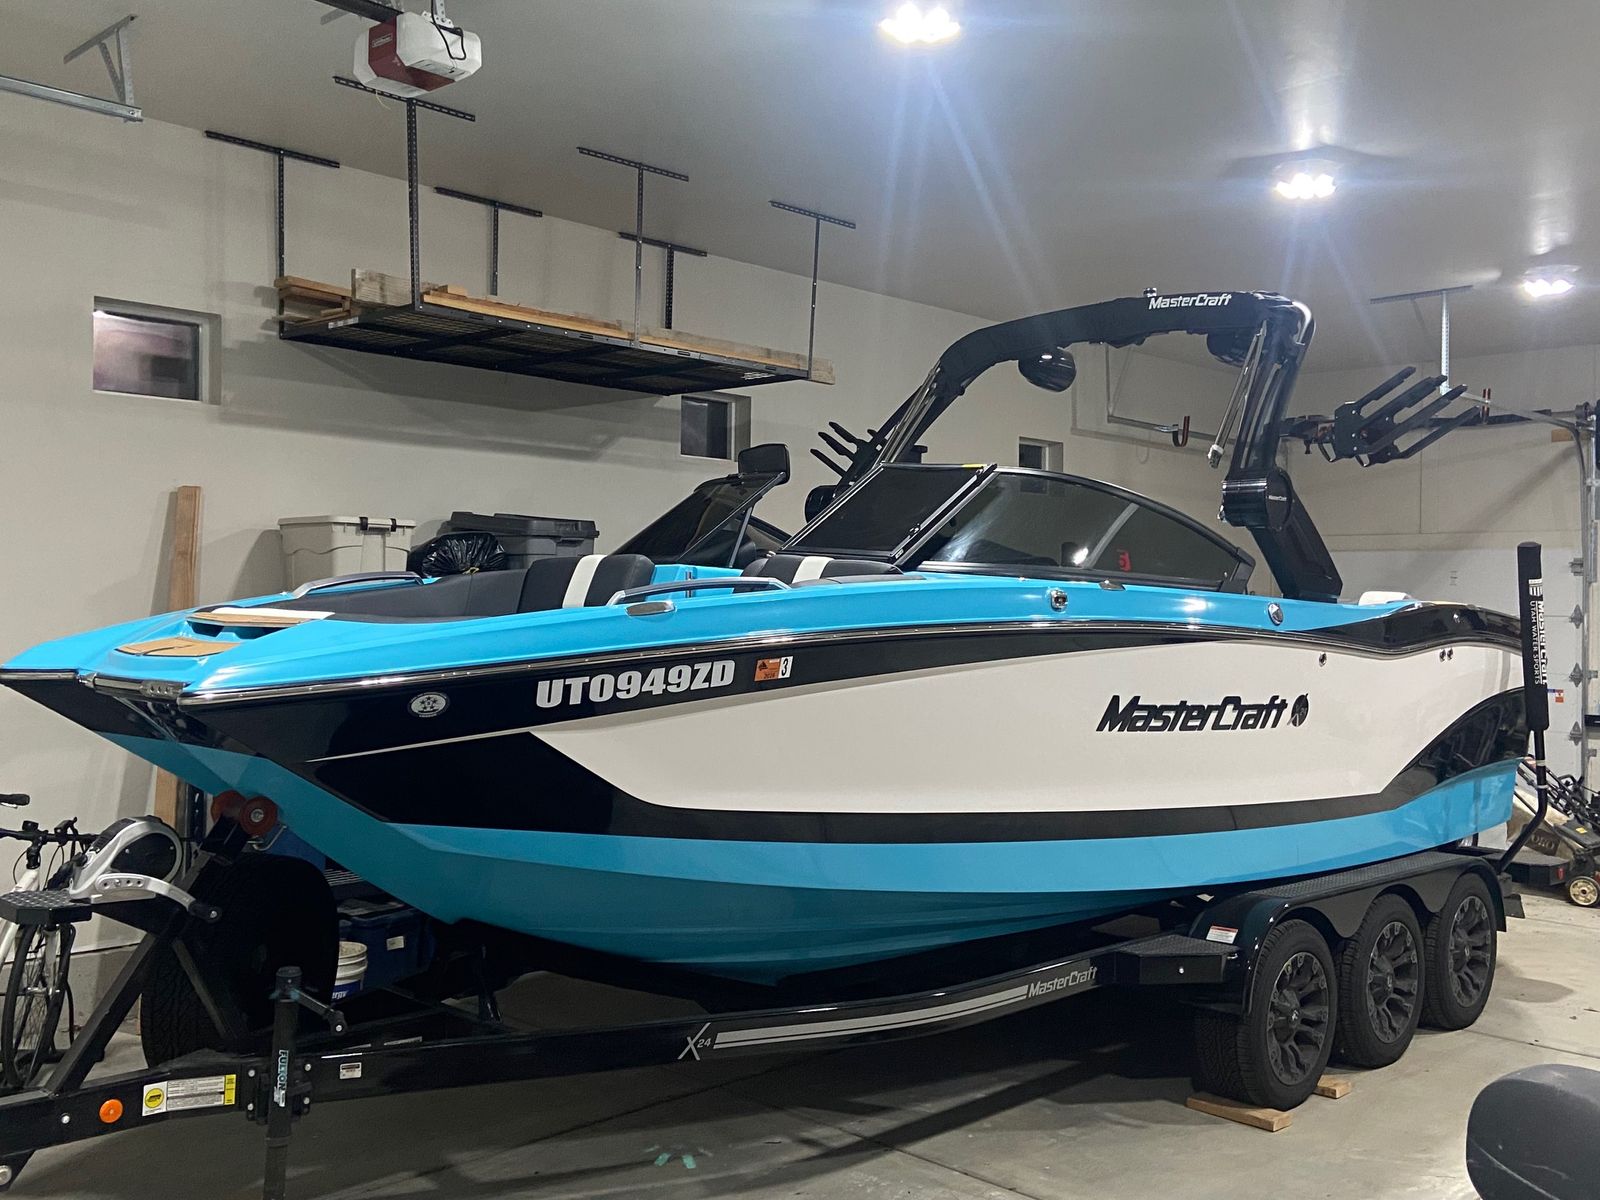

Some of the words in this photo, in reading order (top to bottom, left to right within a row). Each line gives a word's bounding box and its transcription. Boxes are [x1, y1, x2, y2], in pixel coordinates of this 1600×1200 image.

[1148, 293, 1232, 310] MasterCraft
[1529, 600, 1537, 623] UTAH
[1531, 624, 1539, 652] WATER
[781, 657, 789, 677] 3
[1533, 653, 1541, 685] SPORTS
[1096, 694, 1289, 732] MasterCraft
[1028, 966, 1098, 999] MasterCraft
[277, 1049, 289, 1091] FULTON
